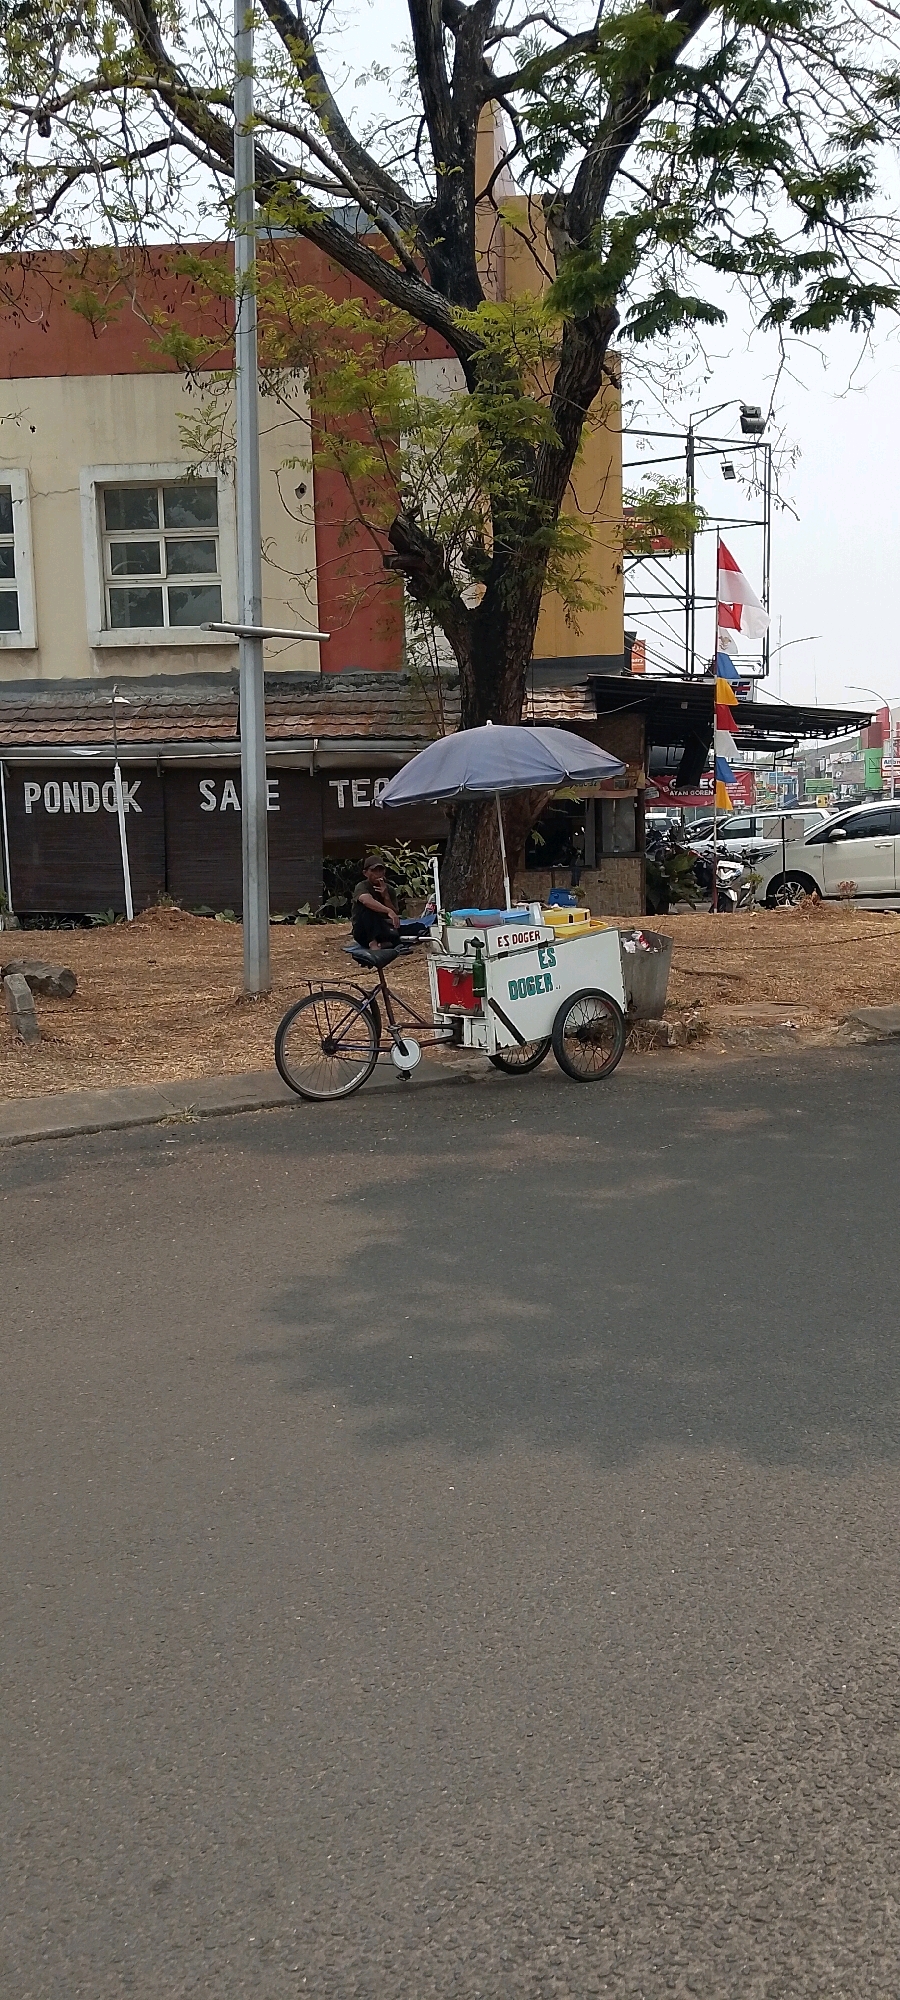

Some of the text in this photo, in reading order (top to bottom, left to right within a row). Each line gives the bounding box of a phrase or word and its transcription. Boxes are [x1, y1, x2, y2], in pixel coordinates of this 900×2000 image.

[23, 780, 144, 814] PONDOK
[199, 779, 281, 812] SAE
[497, 930, 541, 948] ES DOGER
[537, 947, 557, 970] ES
[507, 972, 554, 1001] DOGER
